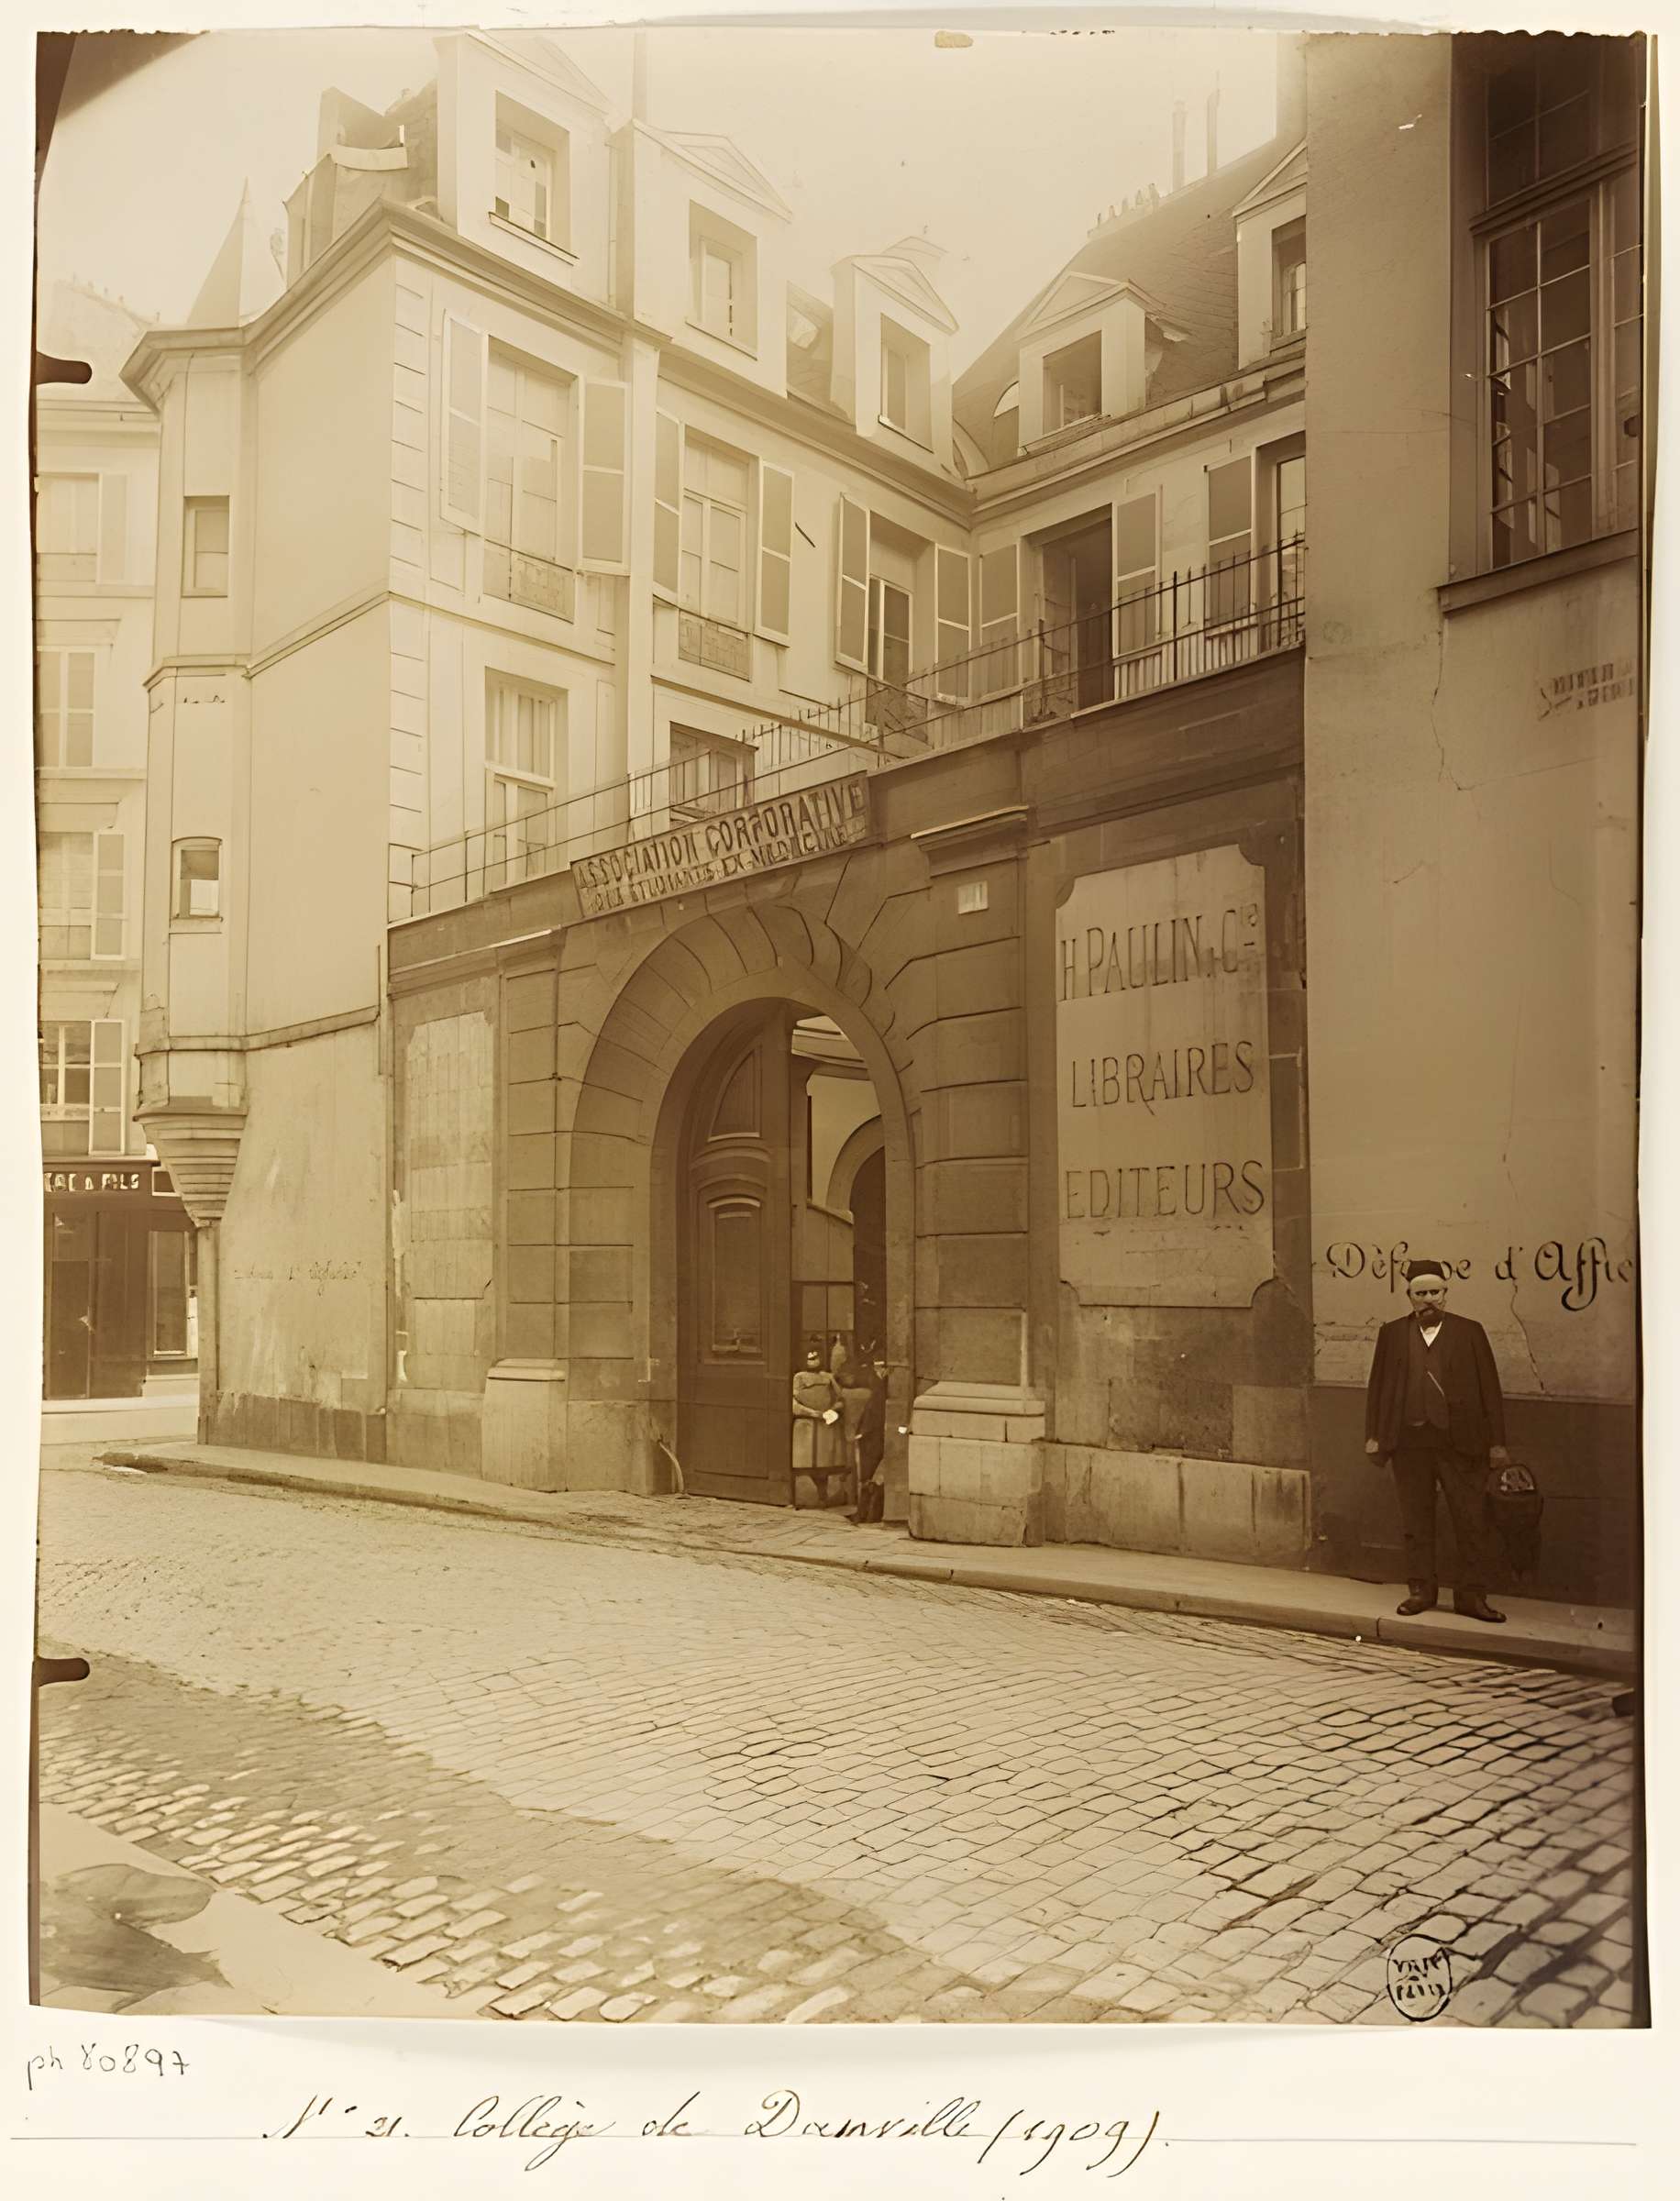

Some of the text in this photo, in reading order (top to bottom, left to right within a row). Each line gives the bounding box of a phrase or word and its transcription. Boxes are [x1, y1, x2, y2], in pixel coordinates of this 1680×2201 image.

[579, 831, 700, 889] ASSOCIATION
[1056, 938, 1078, 1001] H
[1086, 914, 1203, 998] PAULIN
[1071, 1040, 1255, 1116] LIBRAIRES
[1065, 1160, 1266, 1220] EDITEURS
